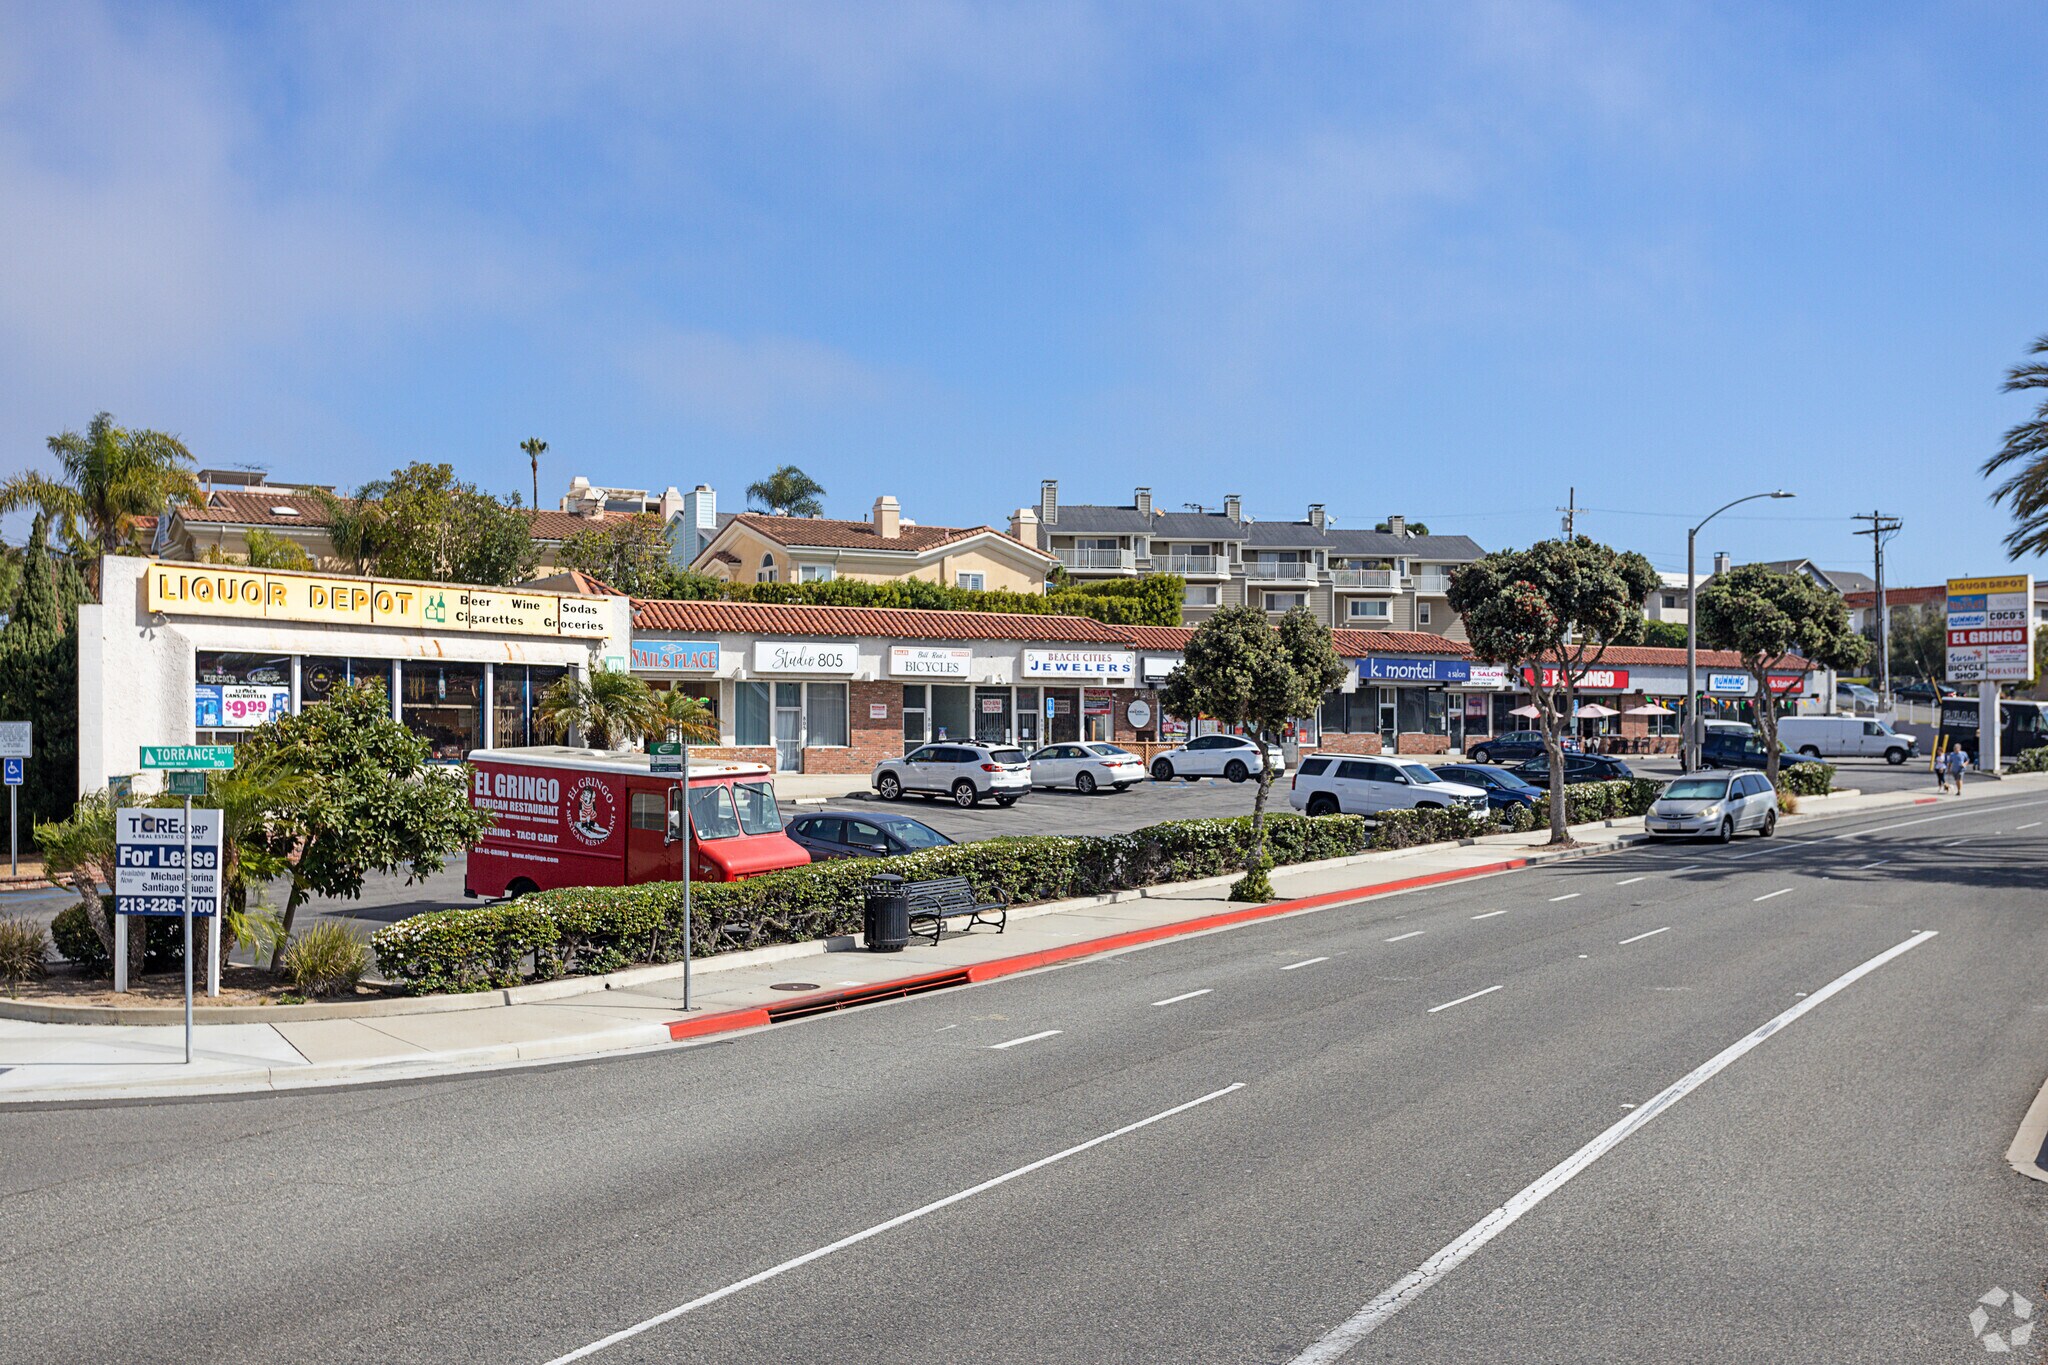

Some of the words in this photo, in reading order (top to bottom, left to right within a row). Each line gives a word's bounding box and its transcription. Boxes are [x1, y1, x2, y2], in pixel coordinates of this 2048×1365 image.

[1949, 582, 1987, 591] LIQUOR
[1989, 580, 2024, 589] DEPOT
[159, 574, 288, 607] LIQUOR
[309, 585, 413, 615] DEPOT
[460, 595, 492, 607] Beer
[511, 598, 541, 611] Wine
[562, 603, 598, 615] Sodas
[455, 612, 524, 626] Cigarettes
[543, 618, 604, 631] Groceries
[1990, 611, 2025, 620] COCO'S
[1952, 632, 1967, 644] EL
[1968, 630, 2022, 643] GRINGO
[632, 649, 670, 668] NAILS
[674, 650, 716, 669] PLACE
[772, 646, 815, 669] Studio
[817, 653, 843, 667] 805
[1048, 653, 1080, 661] BEACH
[1083, 653, 1112, 662] CITIES
[905, 661, 959, 672] BICYCLES
[1031, 660, 1131, 672] JEWELERS
[1386, 660, 1436, 679] monteil
[1451, 669, 1466, 678] salon
[1948, 663, 1985, 672] BICYCLE
[1954, 672, 1979, 680] SHOP
[156, 748, 215, 761] TORRANCE
[475, 771, 492, 796] EL
[494, 773, 560, 803] GRINGO
[567, 786, 580, 801] EL
[578, 776, 614, 804] GRINGO
[474, 797, 508, 811] MEXICAN
[509, 800, 559, 817] RESTAURANT
[516, 830, 536, 841] TACO
[537, 833, 559, 844] CART
[119, 846, 154, 866] For
[151, 872, 184, 881] Michael
[142, 882, 180, 894] Santiago
